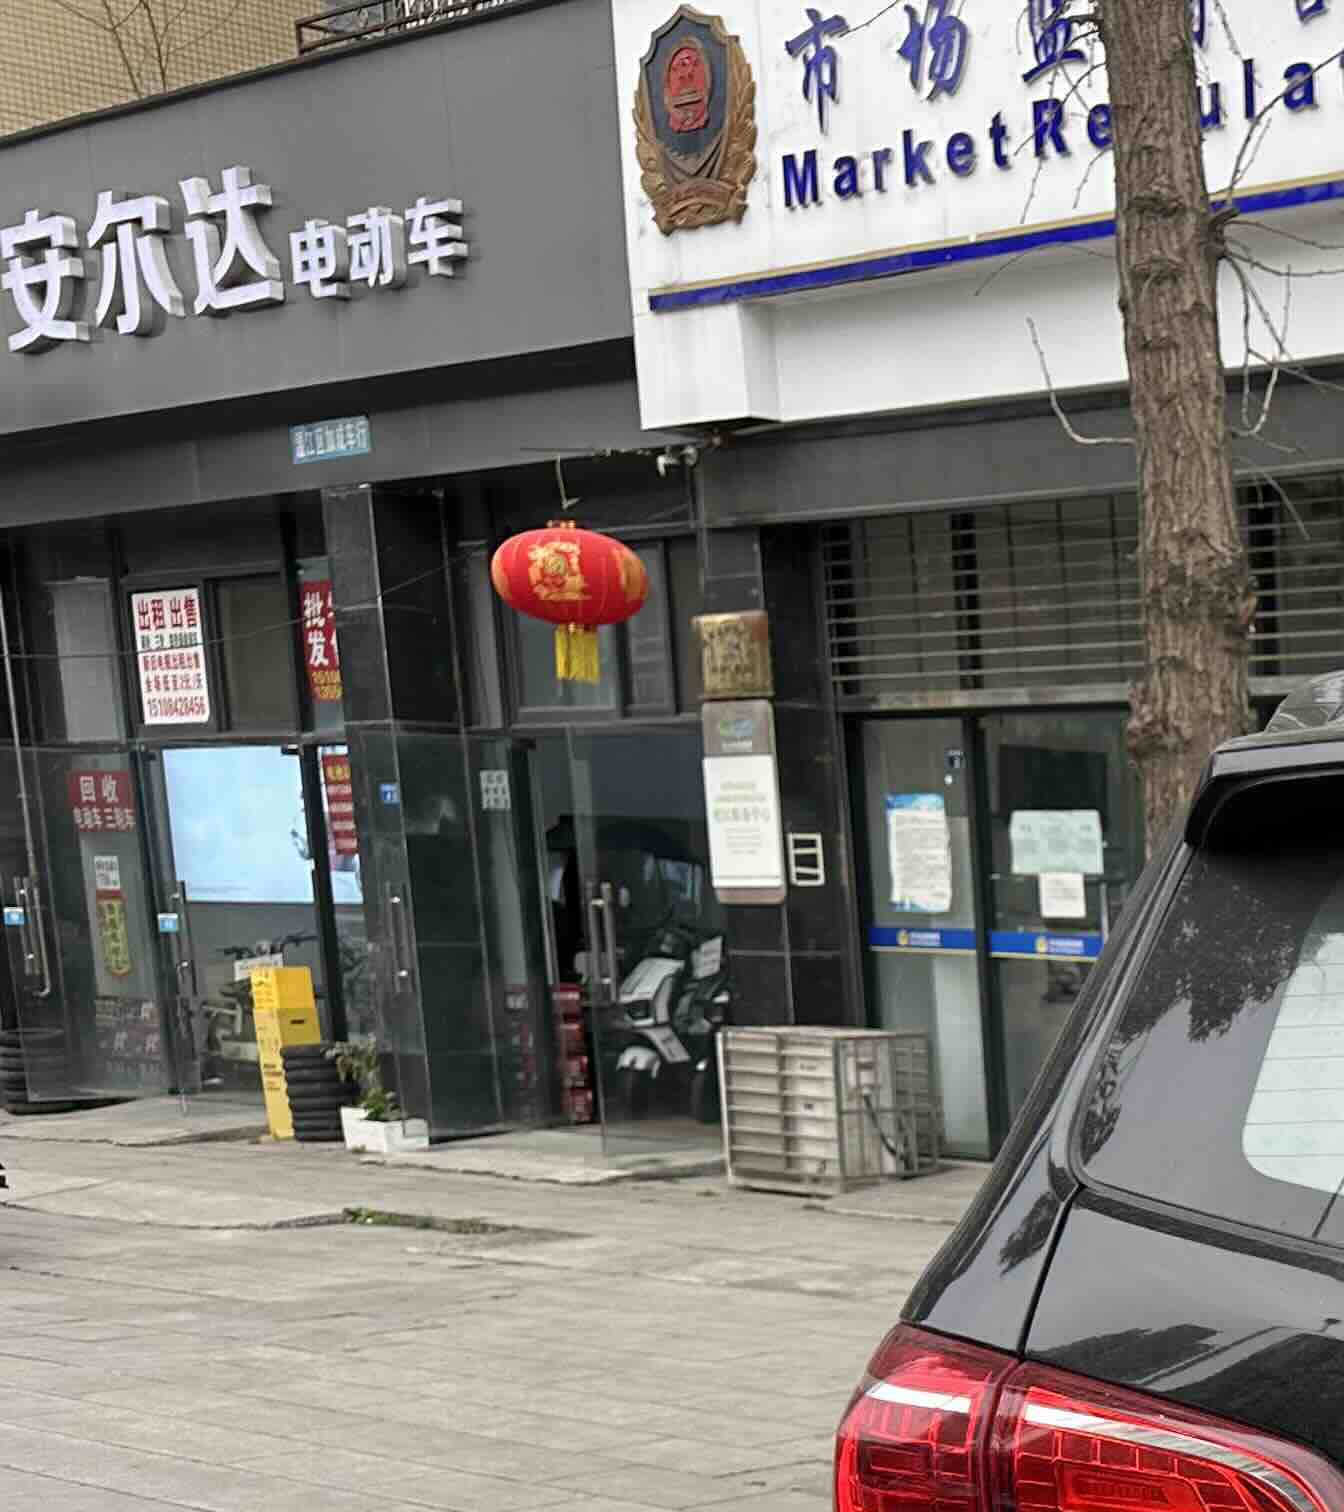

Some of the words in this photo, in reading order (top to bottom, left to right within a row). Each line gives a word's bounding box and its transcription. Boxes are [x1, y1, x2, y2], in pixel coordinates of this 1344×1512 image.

[0, 166, 283, 352] 安尔达
[291, 197, 468, 298] 电动车
[138, 598, 166, 631] 出租
[80, 775, 119, 803] 回收
